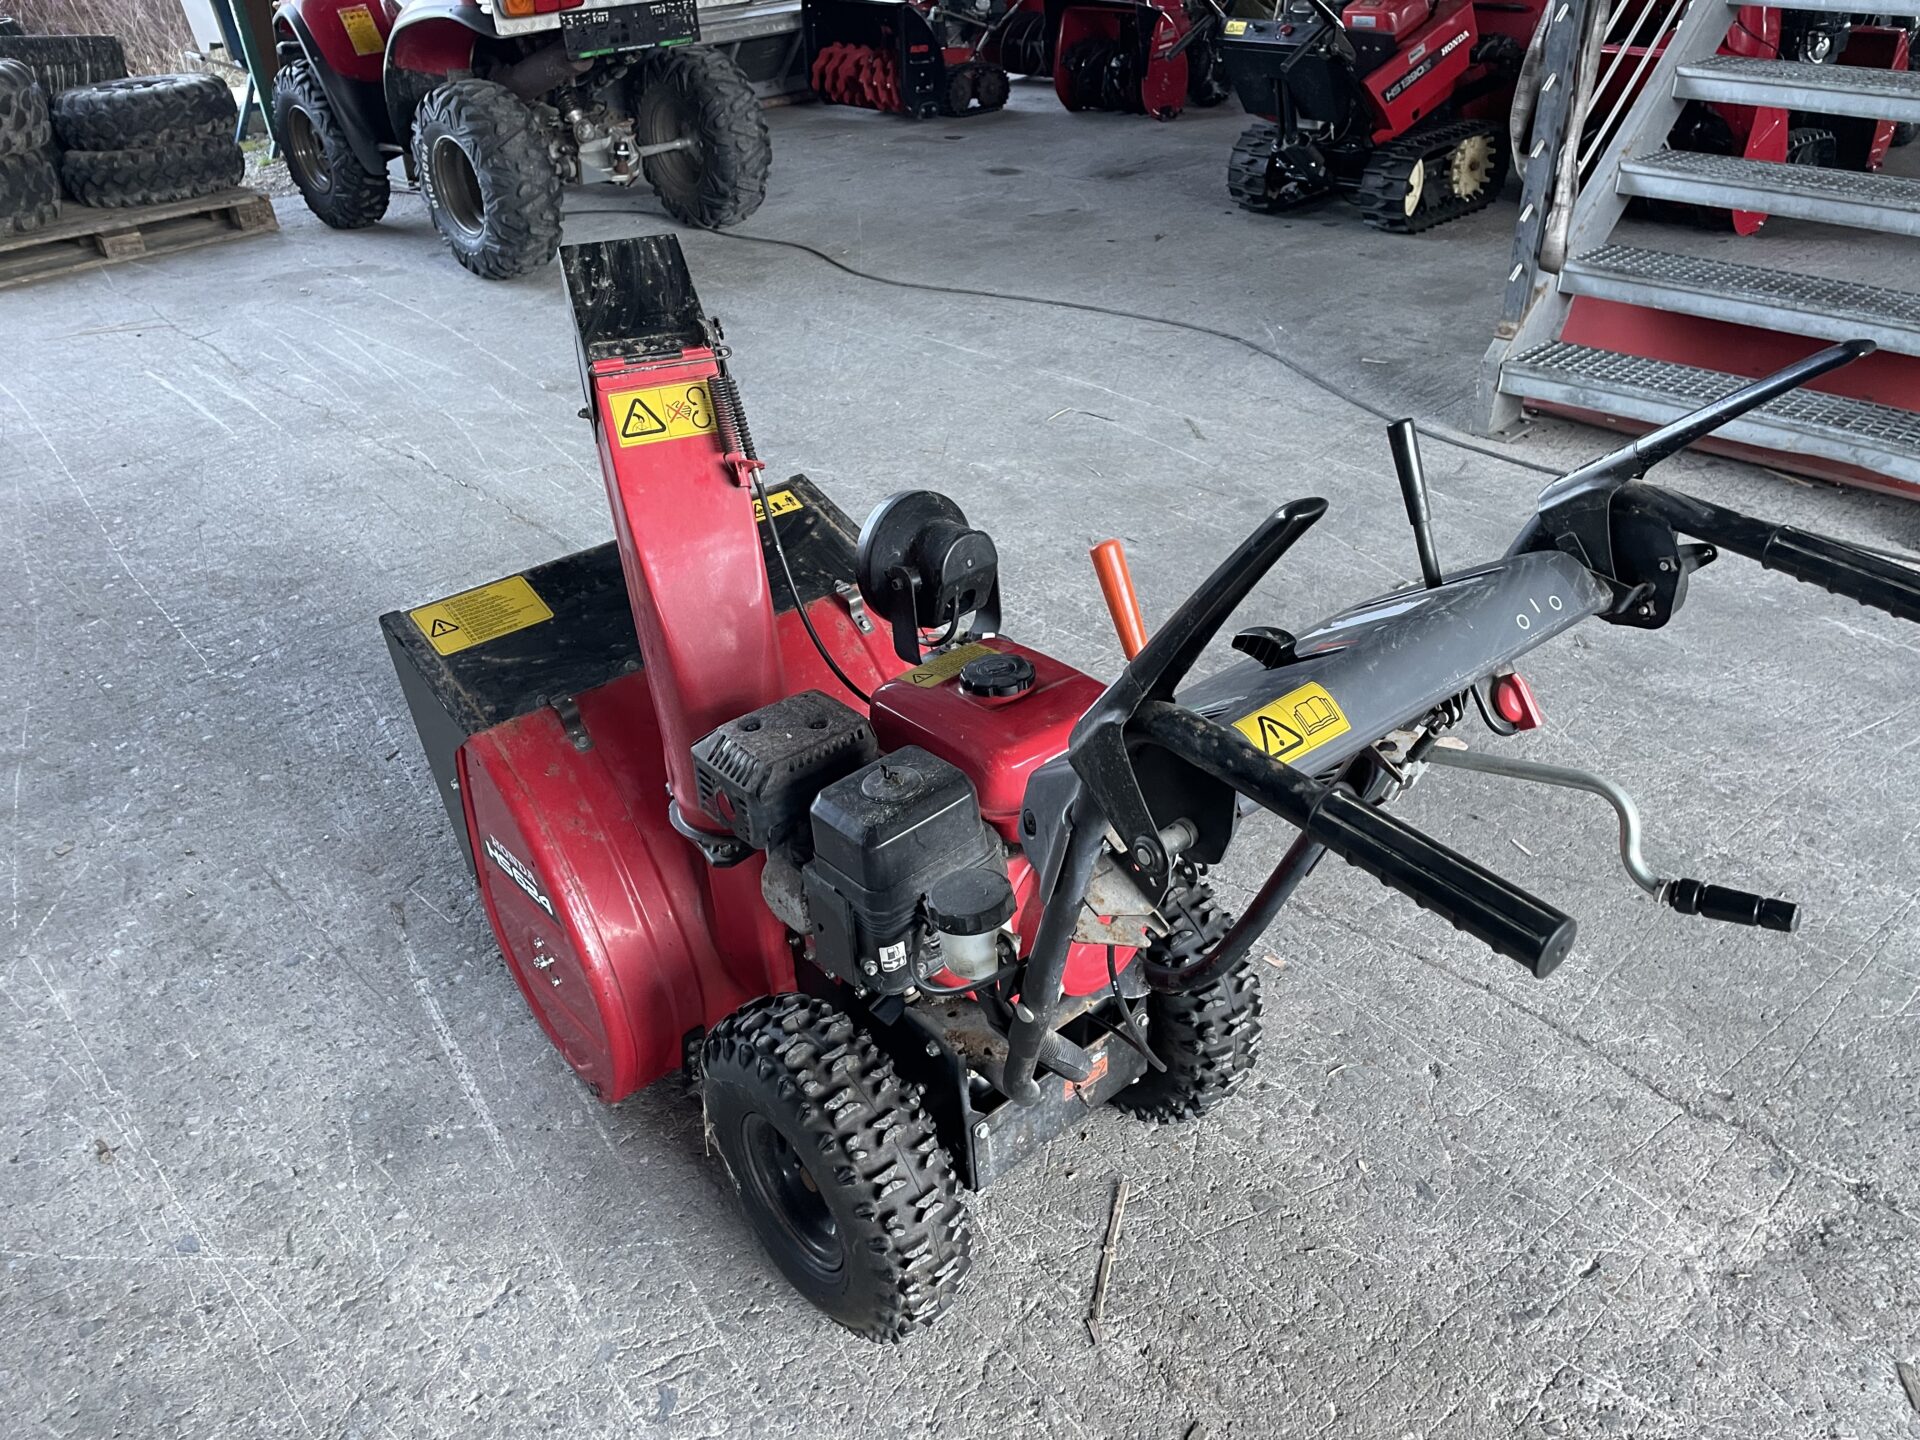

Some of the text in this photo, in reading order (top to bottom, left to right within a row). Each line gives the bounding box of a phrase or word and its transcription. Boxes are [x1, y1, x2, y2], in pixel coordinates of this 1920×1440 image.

[1440, 29, 1470, 57] HONDA
[485, 839, 554, 916] HS624
[489, 833, 538, 887] HONDA
